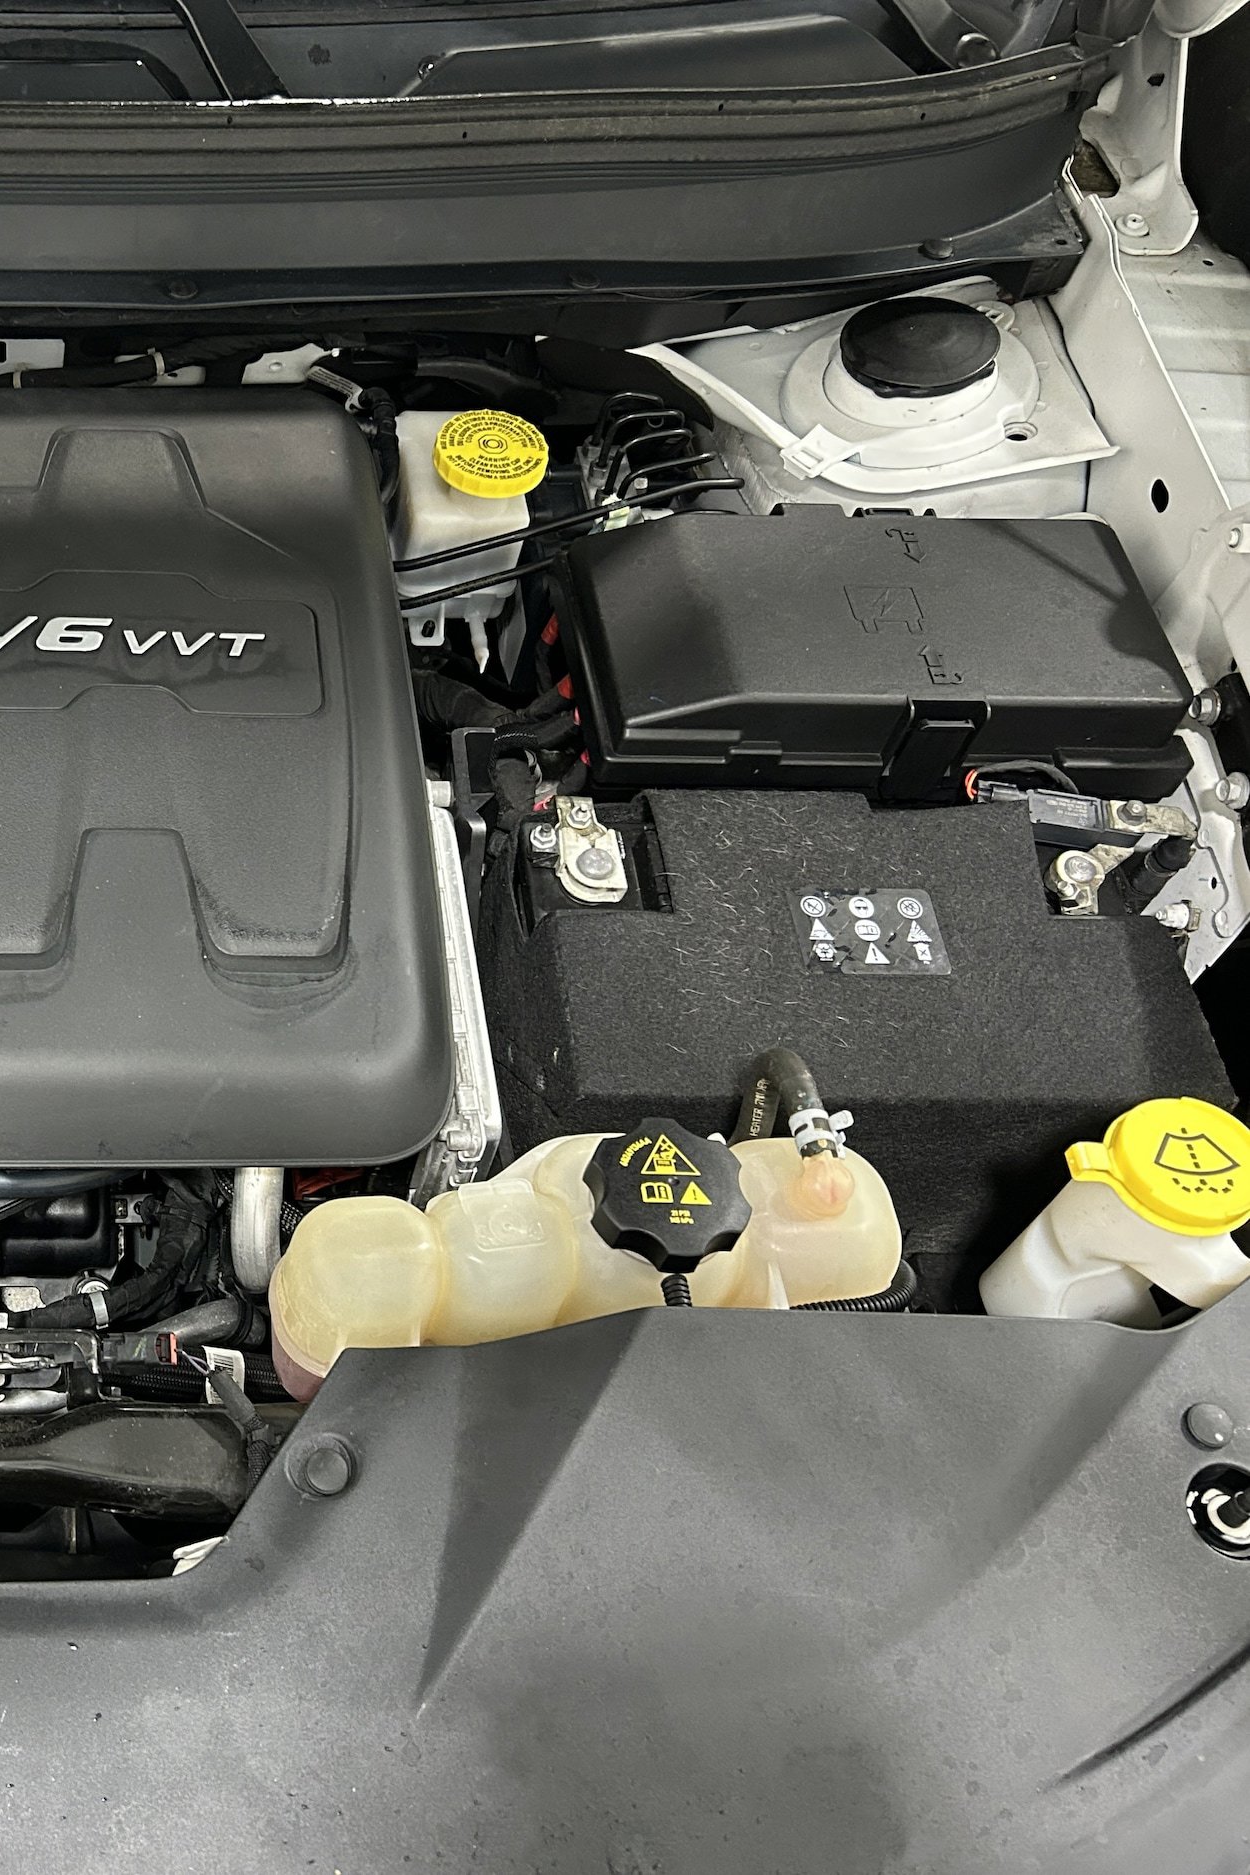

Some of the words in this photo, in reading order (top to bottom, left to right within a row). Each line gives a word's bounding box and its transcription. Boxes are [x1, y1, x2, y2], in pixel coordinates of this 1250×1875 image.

[490, 410, 519, 422] BOUCHON
[455, 422, 463, 430] LE
[462, 416, 486, 425] RETIRER
[487, 416, 514, 426] UTILISER
[514, 424, 537, 448] UNIQUEMENT
[465, 426, 496, 443] CONTENANT
[489, 421, 524, 438] PROVENANT
[455, 454, 476, 469] BEFORE
[512, 464, 525, 472] USE
[468, 456, 489, 468] CLEAN
[478, 454, 510, 462] WARNING
[459, 465, 475, 475] FLUID
[475, 471, 493, 479] FROM
[499, 472, 521, 480] SEALED
[123, 630, 266, 657] VVT
[750, 1108, 764, 1137] HEATER
